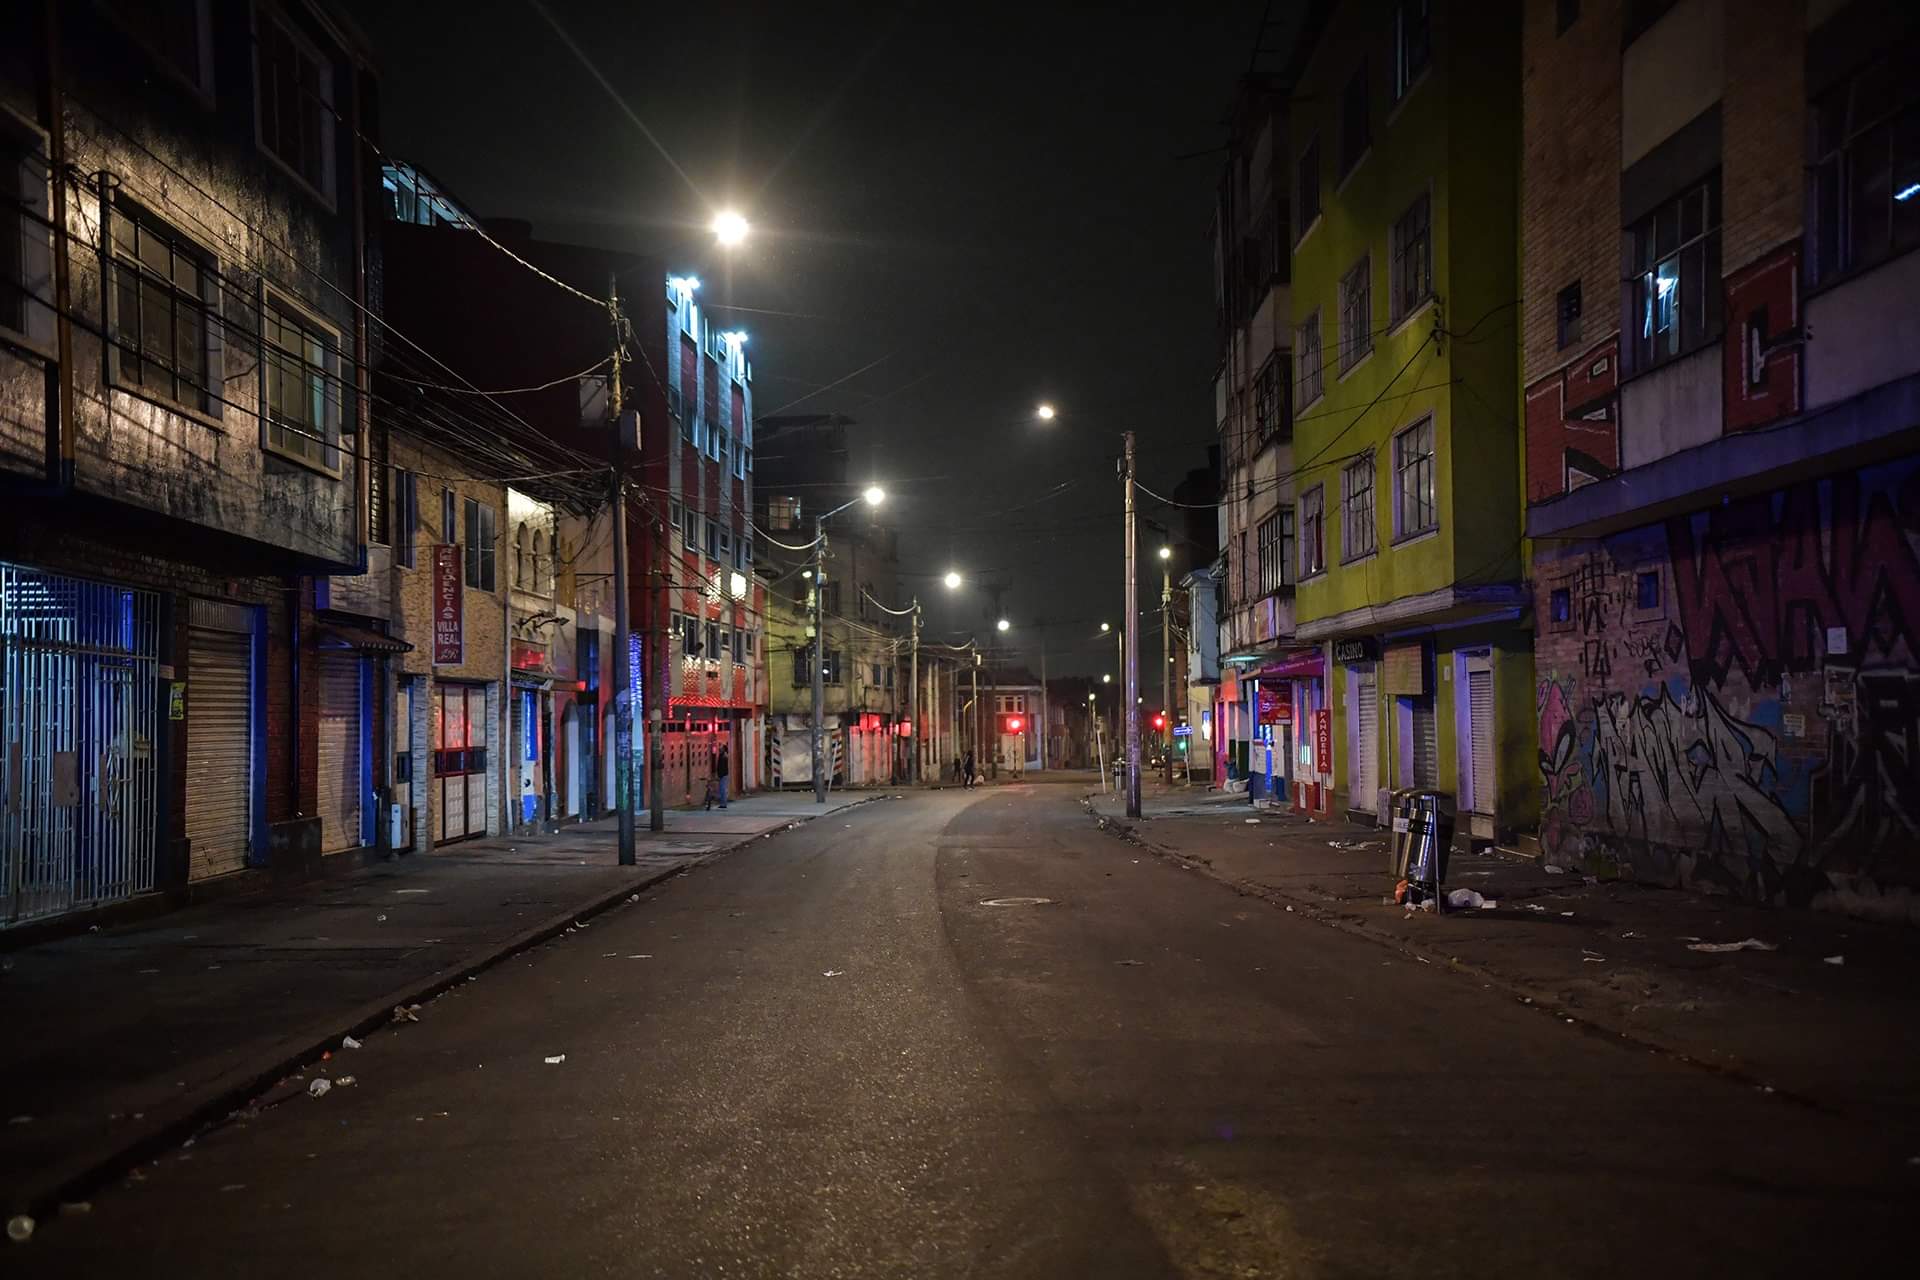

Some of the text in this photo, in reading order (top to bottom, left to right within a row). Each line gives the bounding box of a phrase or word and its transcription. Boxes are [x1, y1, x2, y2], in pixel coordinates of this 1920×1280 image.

[437, 621, 459, 633] VILLA
[438, 633, 460, 645] REAL
[1335, 641, 1364, 661] CASINO
[1319, 711, 1328, 768] PANADERIA
